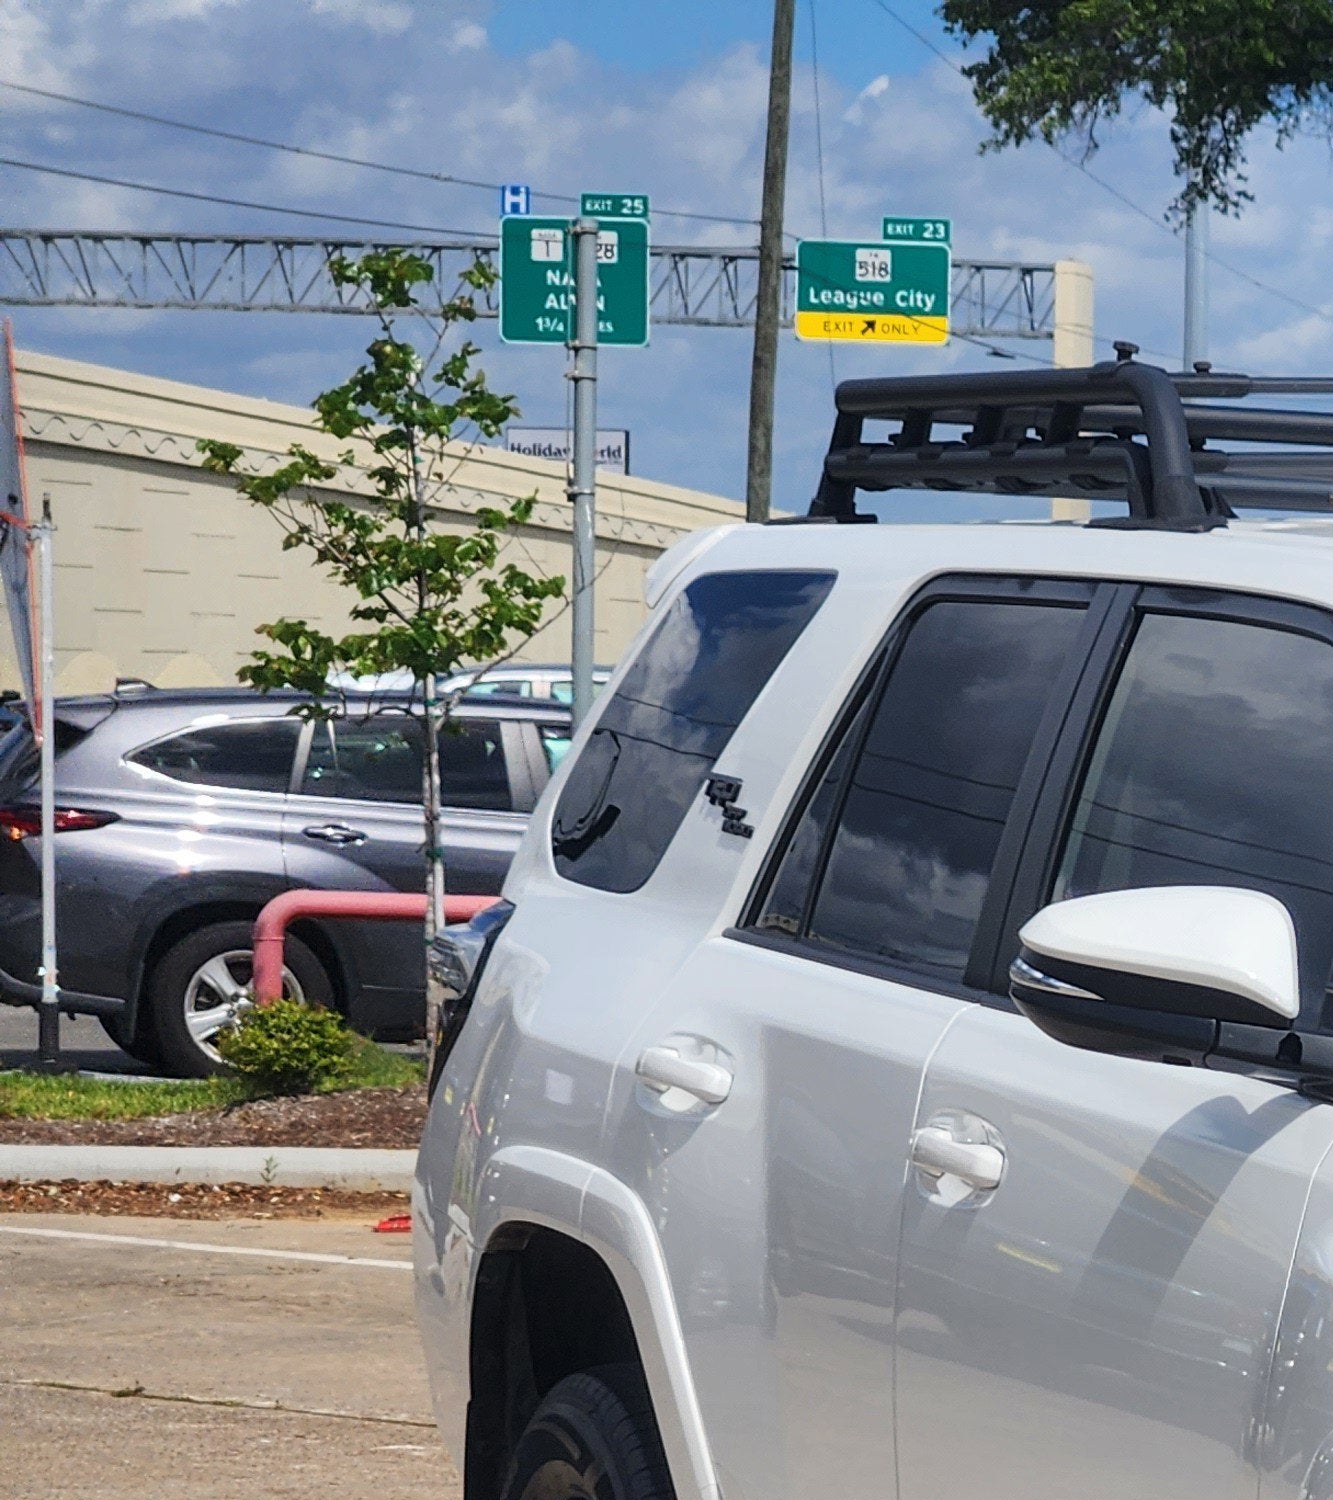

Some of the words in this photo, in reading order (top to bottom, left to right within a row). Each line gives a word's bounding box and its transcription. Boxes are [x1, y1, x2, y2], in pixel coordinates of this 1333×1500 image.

[585, 201, 612, 212] EXIT
[620, 198, 646, 215] 25
[886, 223, 914, 236] EXIT
[922, 222, 946, 239] 23
[858, 260, 889, 278] 518
[808, 286, 885, 309] League
[895, 288, 936, 312] City
[823, 321, 855, 333] EXIT
[880, 323, 922, 336] ONLY
